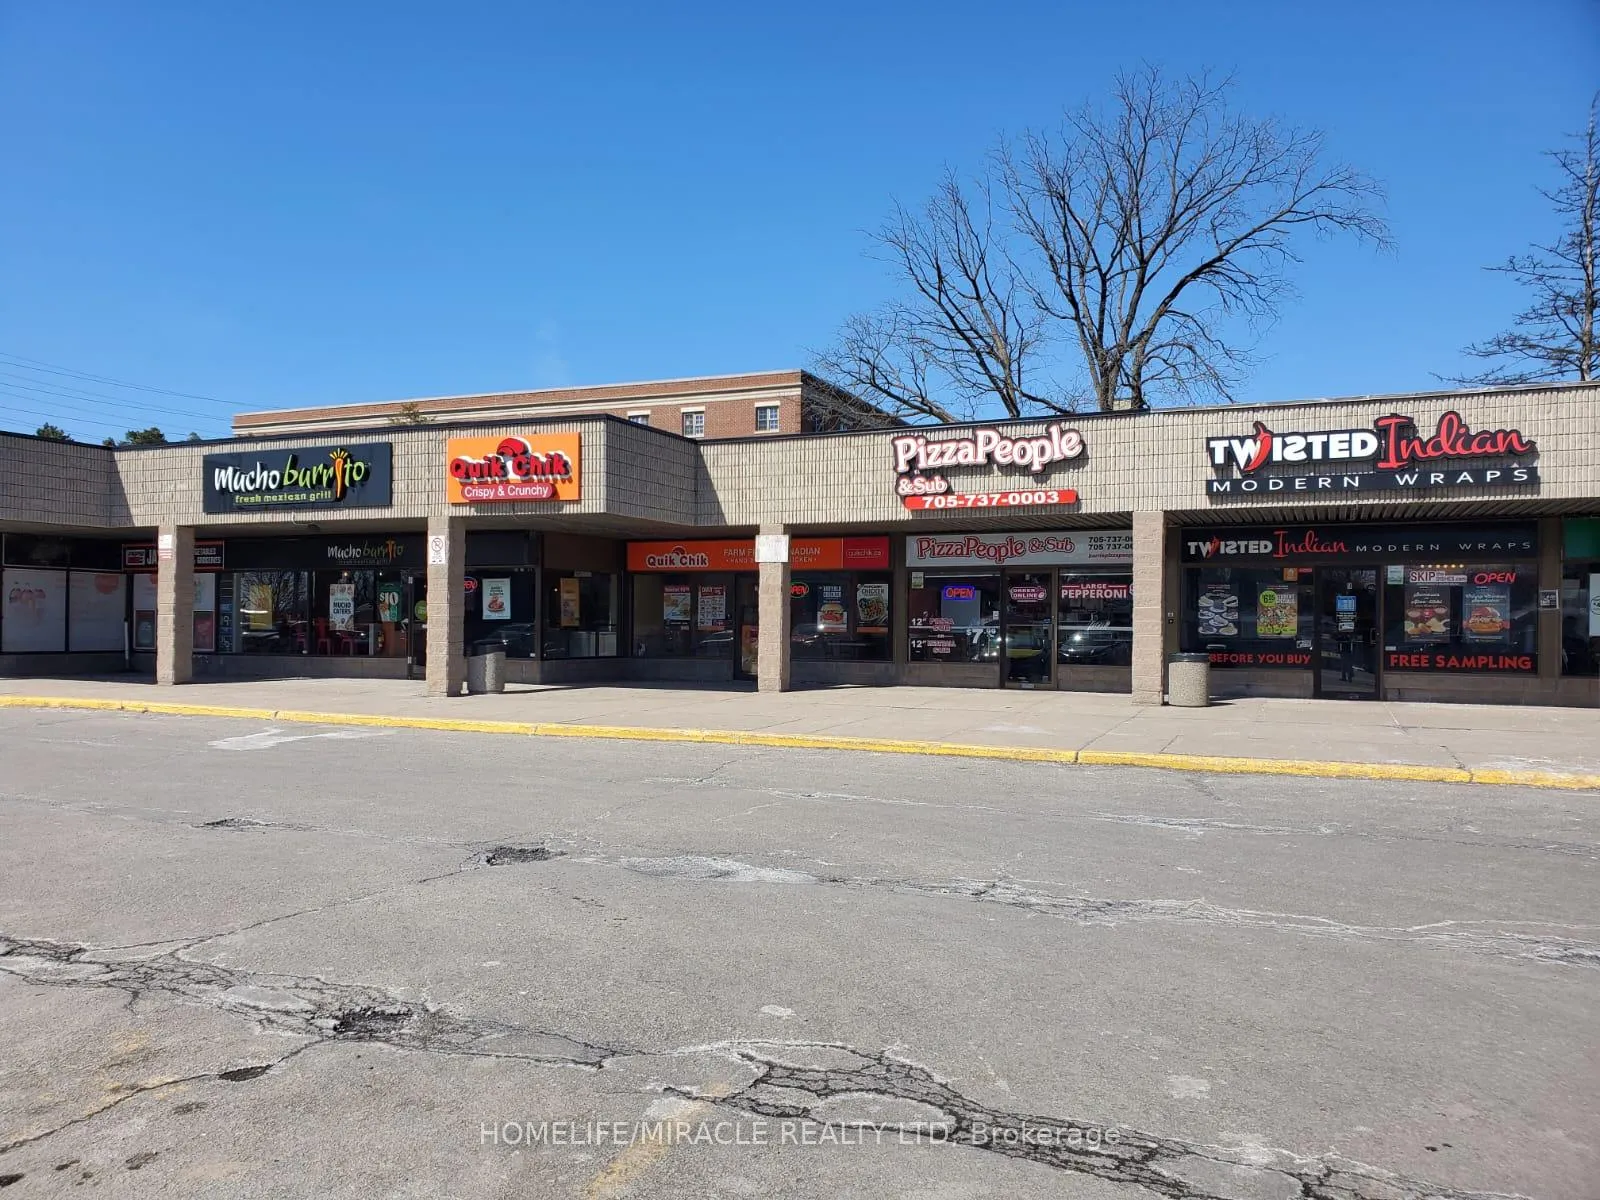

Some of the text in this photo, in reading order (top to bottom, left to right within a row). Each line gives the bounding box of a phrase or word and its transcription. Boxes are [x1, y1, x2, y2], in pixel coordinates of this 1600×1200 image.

[1209, 414, 1532, 470] TWISTED Indian
[450, 451, 568, 480] Quik Chik
[1212, 469, 1529, 493] MODERN WRAPS
[235, 491, 332, 503] fresh mexican grill
[464, 485, 549, 499] Crispy & Crunchy
[921, 491, 1060, 509] 705-737-0003
[1187, 530, 1350, 559] TWISTED Indian
[1355, 541, 1532, 552] MODERN WRAPS
[723, 549, 746, 557] FARM
[646, 553, 709, 567] Quik Chik
[1410, 572, 1436, 582] SKIP
[1474, 572, 1517, 584] OPEN
[945, 587, 975, 599] OPEN
[1061, 589, 1127, 599] PEPPERONI
[1208, 653, 1312, 664] BEFORE YOU BUY
[1389, 654, 1532, 669] FREE SAMPLING
